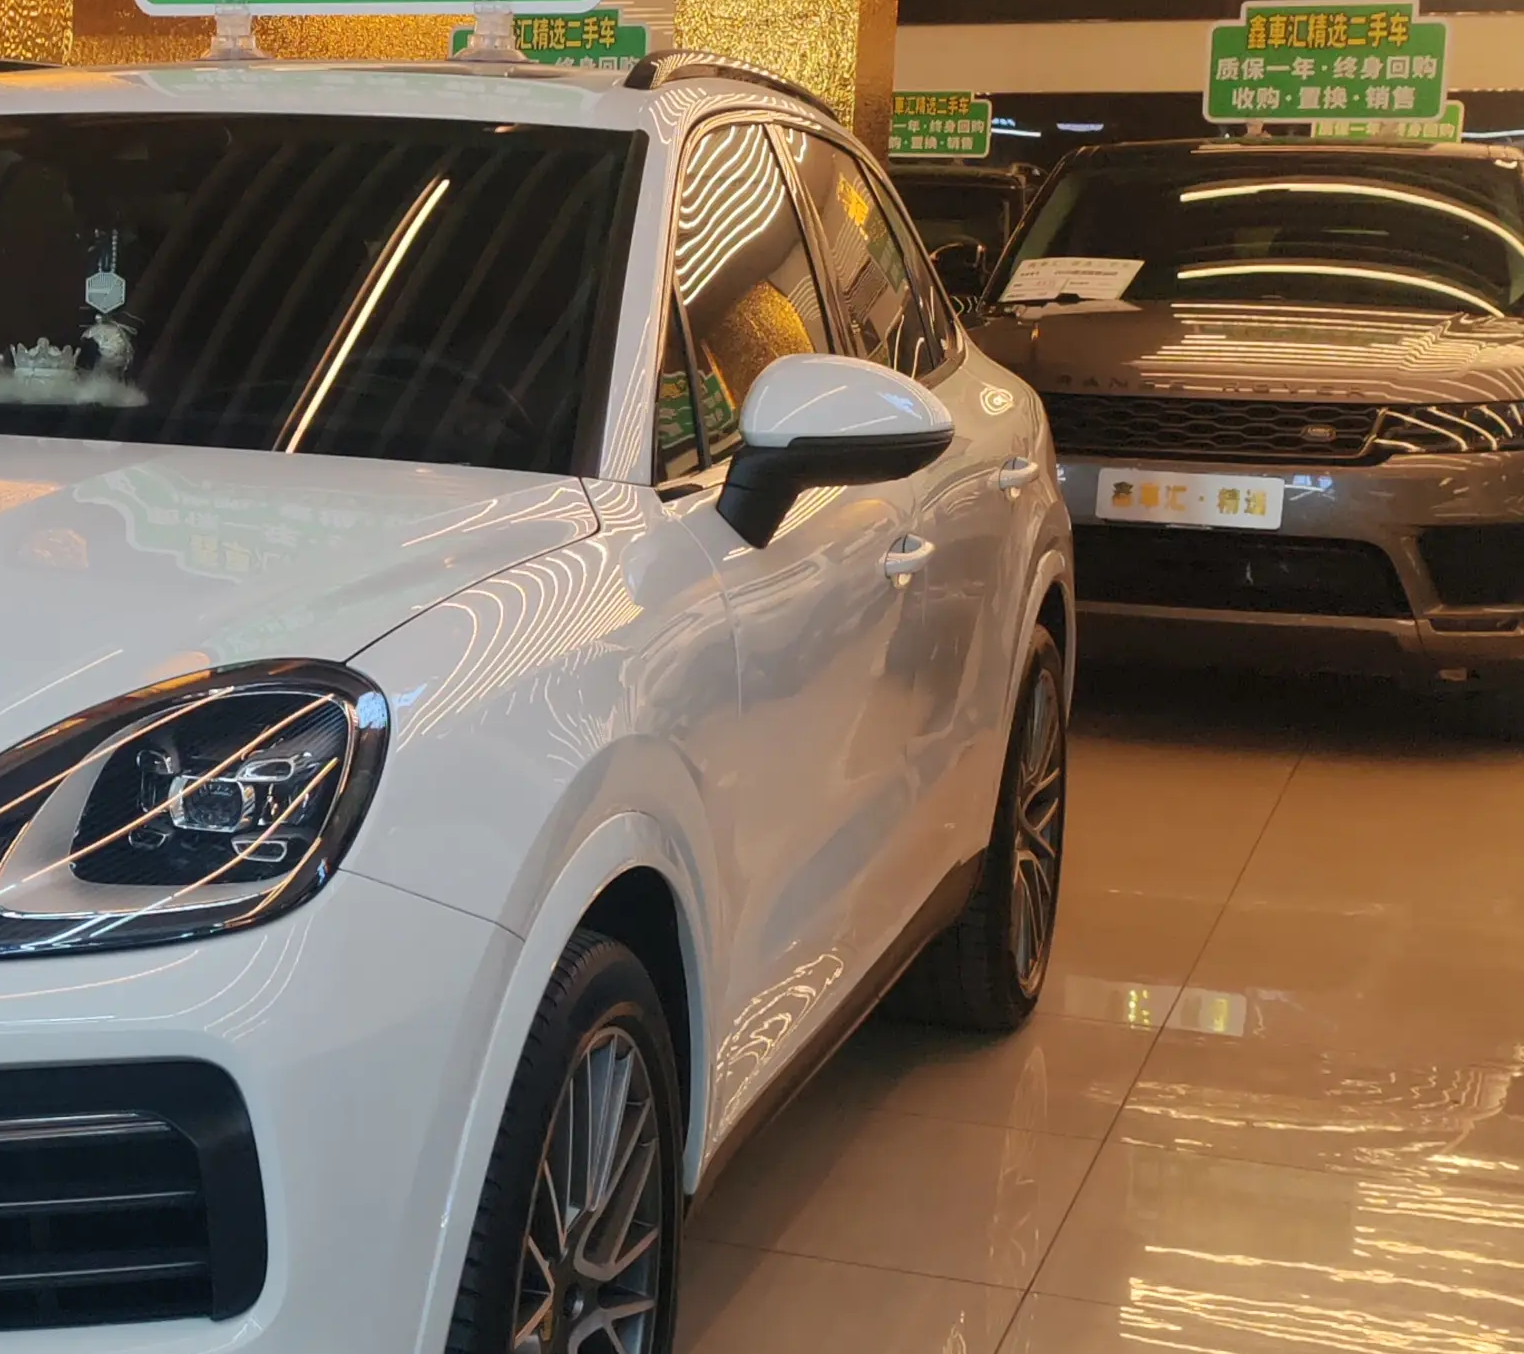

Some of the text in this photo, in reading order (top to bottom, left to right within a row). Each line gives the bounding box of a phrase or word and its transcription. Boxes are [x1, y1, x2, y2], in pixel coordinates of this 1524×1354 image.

[510, 16, 616, 51] 汇精选二手车
[1247, 11, 1409, 49] 鑫車汇精选二手车
[1216, 55, 1438, 81] 质保一年·终身回购
[890, 119, 985, 134] 一年·终身回购
